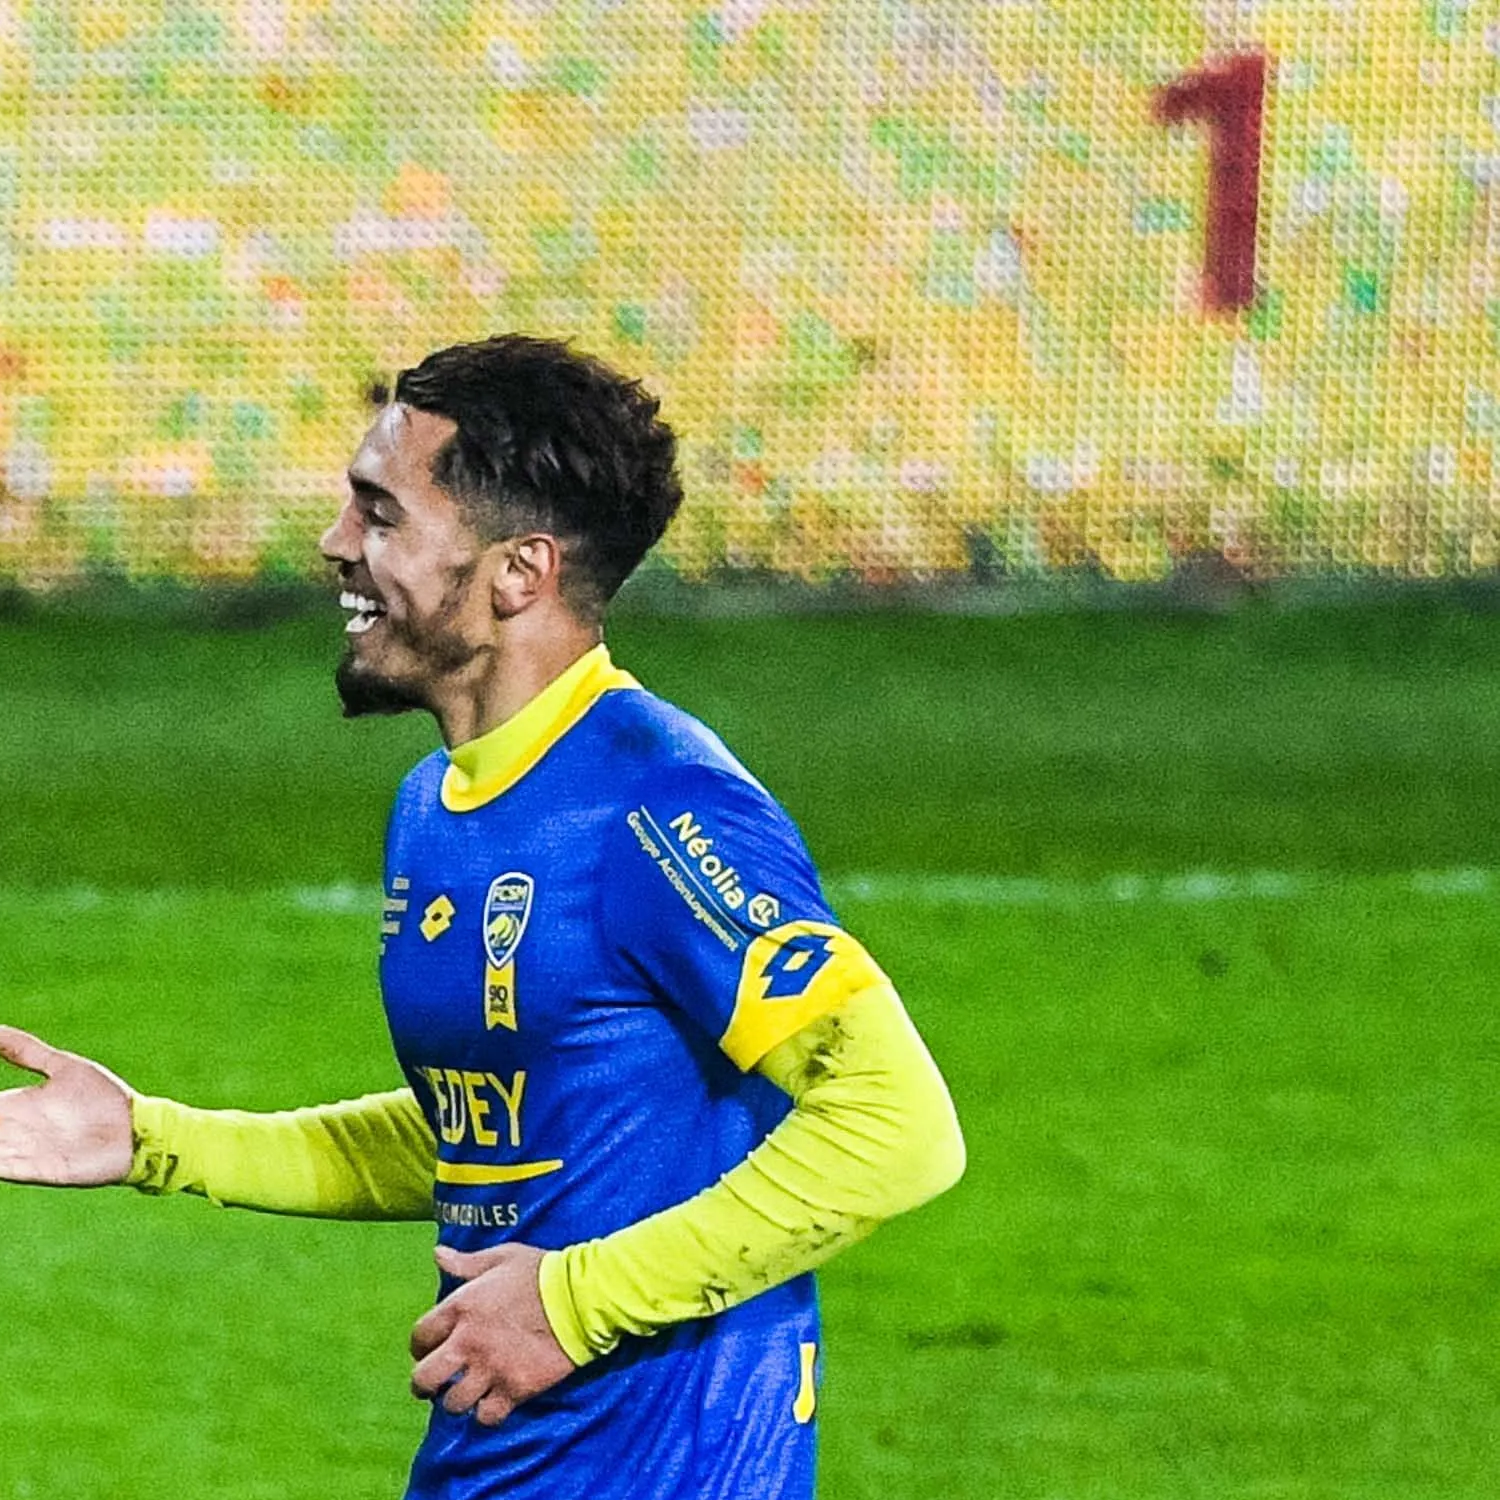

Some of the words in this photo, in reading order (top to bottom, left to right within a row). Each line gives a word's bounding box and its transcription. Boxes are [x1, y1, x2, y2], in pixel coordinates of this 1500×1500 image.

[1153, 52, 1265, 308] 1
[668, 811, 746, 910] Néolia
[416, 1066, 527, 1148] EDEY
